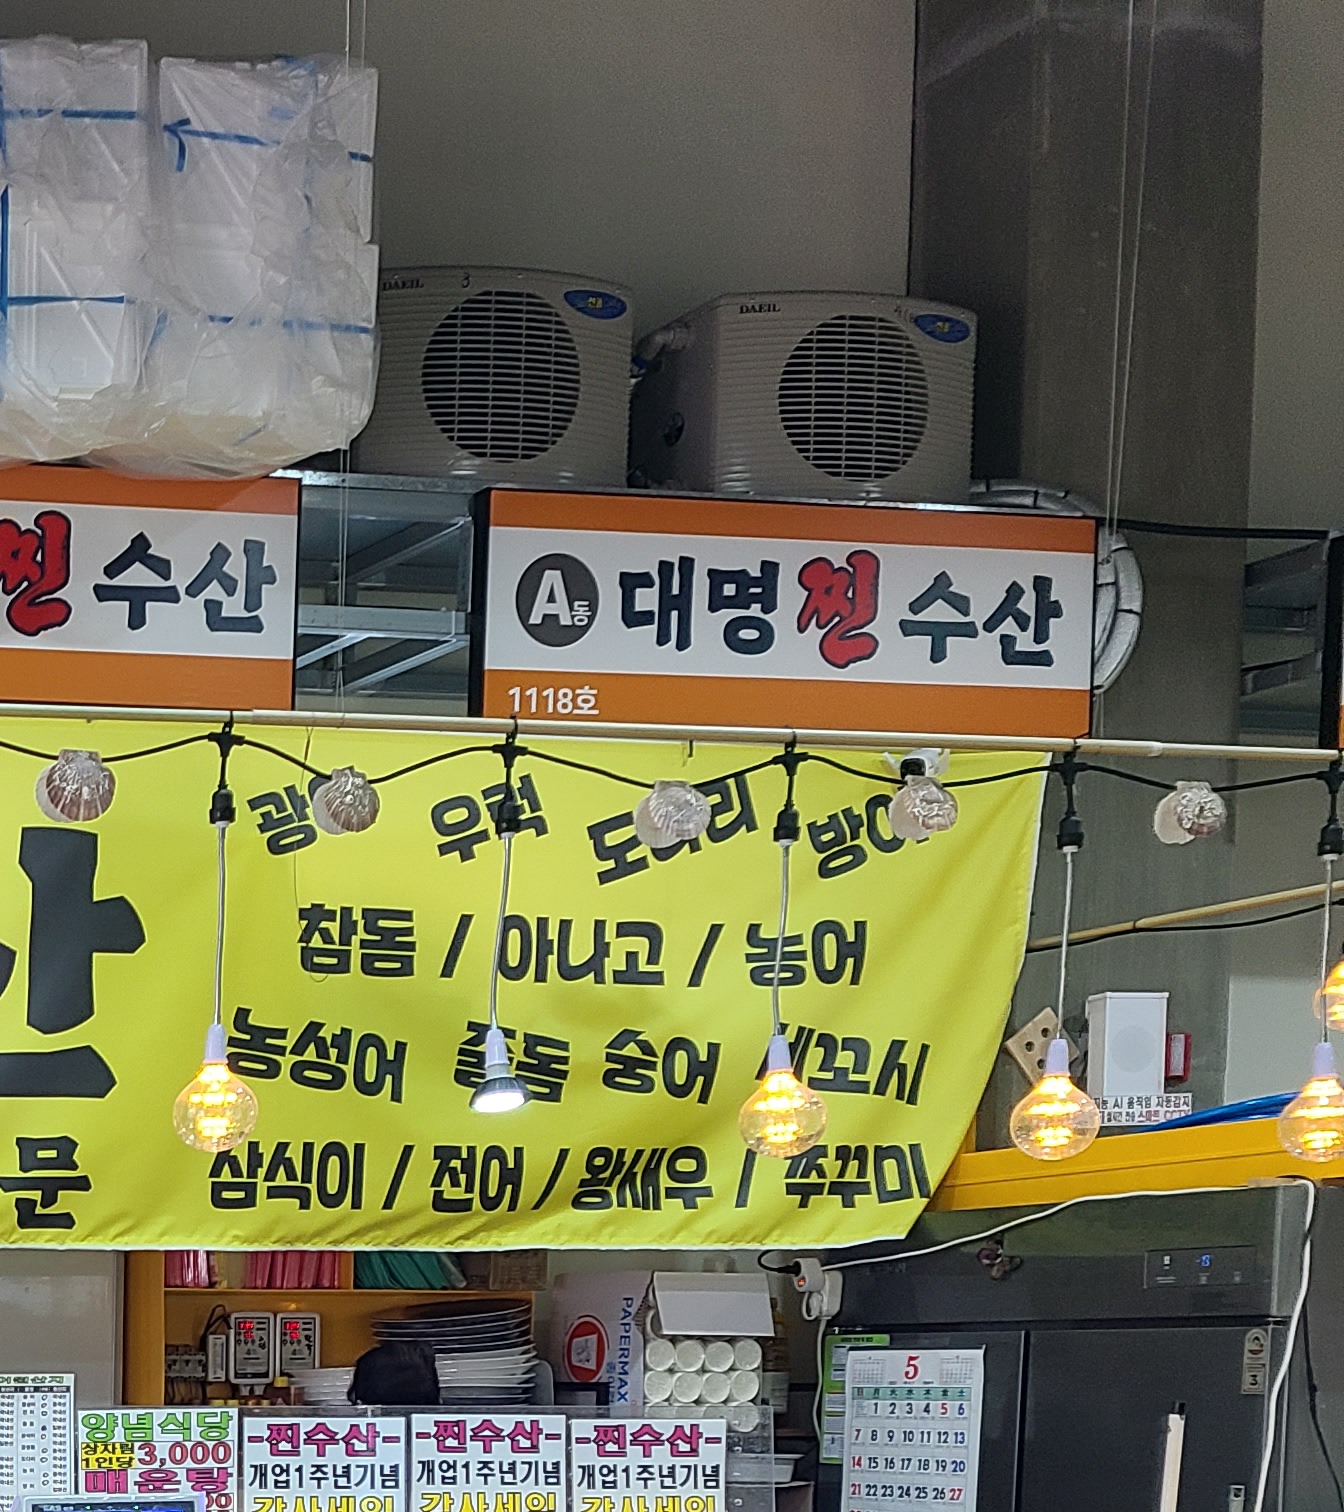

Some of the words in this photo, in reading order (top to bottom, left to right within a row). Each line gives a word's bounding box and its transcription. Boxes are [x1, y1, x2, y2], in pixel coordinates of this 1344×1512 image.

[382, 279, 424, 291] DAEIL
[739, 303, 780, 315] DAEIL
[507, 685, 600, 717] 1118호
[587, 773, 761, 886] 도리
[296, 902, 417, 978] 참돔
[498, 914, 665, 986] 아나고
[745, 919, 868, 988] 농어
[226, 1006, 409, 1104] 농성어
[602, 1028, 721, 1105] 숭어
[208, 1140, 366, 1210] 삼식이
[429, 1144, 524, 1213] 전어
[571, 1145, 713, 1211] 왕새우
[783, 1142, 932, 1209] 쭈꾸미
[618, 1298, 633, 1402] PAPERMAX
[904, 1355, 920, 1379] 5
[874, 1402, 878, 1414] 1
[889, 1403, 896, 1414] 2
[906, 1403, 913, 1414] 3
[923, 1403, 930, 1415] 4
[941, 1403, 947, 1415] 5
[958, 1404, 965, 1415] 6
[81, 1411, 233, 1441] 양념식당
[855, 1429, 861, 1440] 7
[871, 1430, 877, 1441] 8
[888, 1430, 894, 1442] 9
[903, 1431, 914, 1442] 10
[920, 1431, 931, 1443] 11
[937, 1431, 949, 1443] 12
[954, 1432, 965, 1444] 13
[82, 1457, 135, 1468] 1인당
[138, 1441, 232, 1468] 3,000
[852, 1456, 862, 1468] 14
[868, 1457, 878, 1469] 15
[884, 1458, 895, 1469] 16
[901, 1458, 911, 1470] 17
[918, 1459, 929, 1470] 18
[935, 1460, 946, 1471] 19
[952, 1461, 965, 1472] 20
[85, 1468, 233, 1493] 매운탕
[851, 1483, 861, 1495] 21
[866, 1484, 877, 1496] 22
[882, 1485, 894, 1497] 23
[898, 1486, 911, 1498] 24
[915, 1487, 928, 1499] 25
[932, 1488, 945, 1499] 26
[950, 1488, 962, 1500] 27
